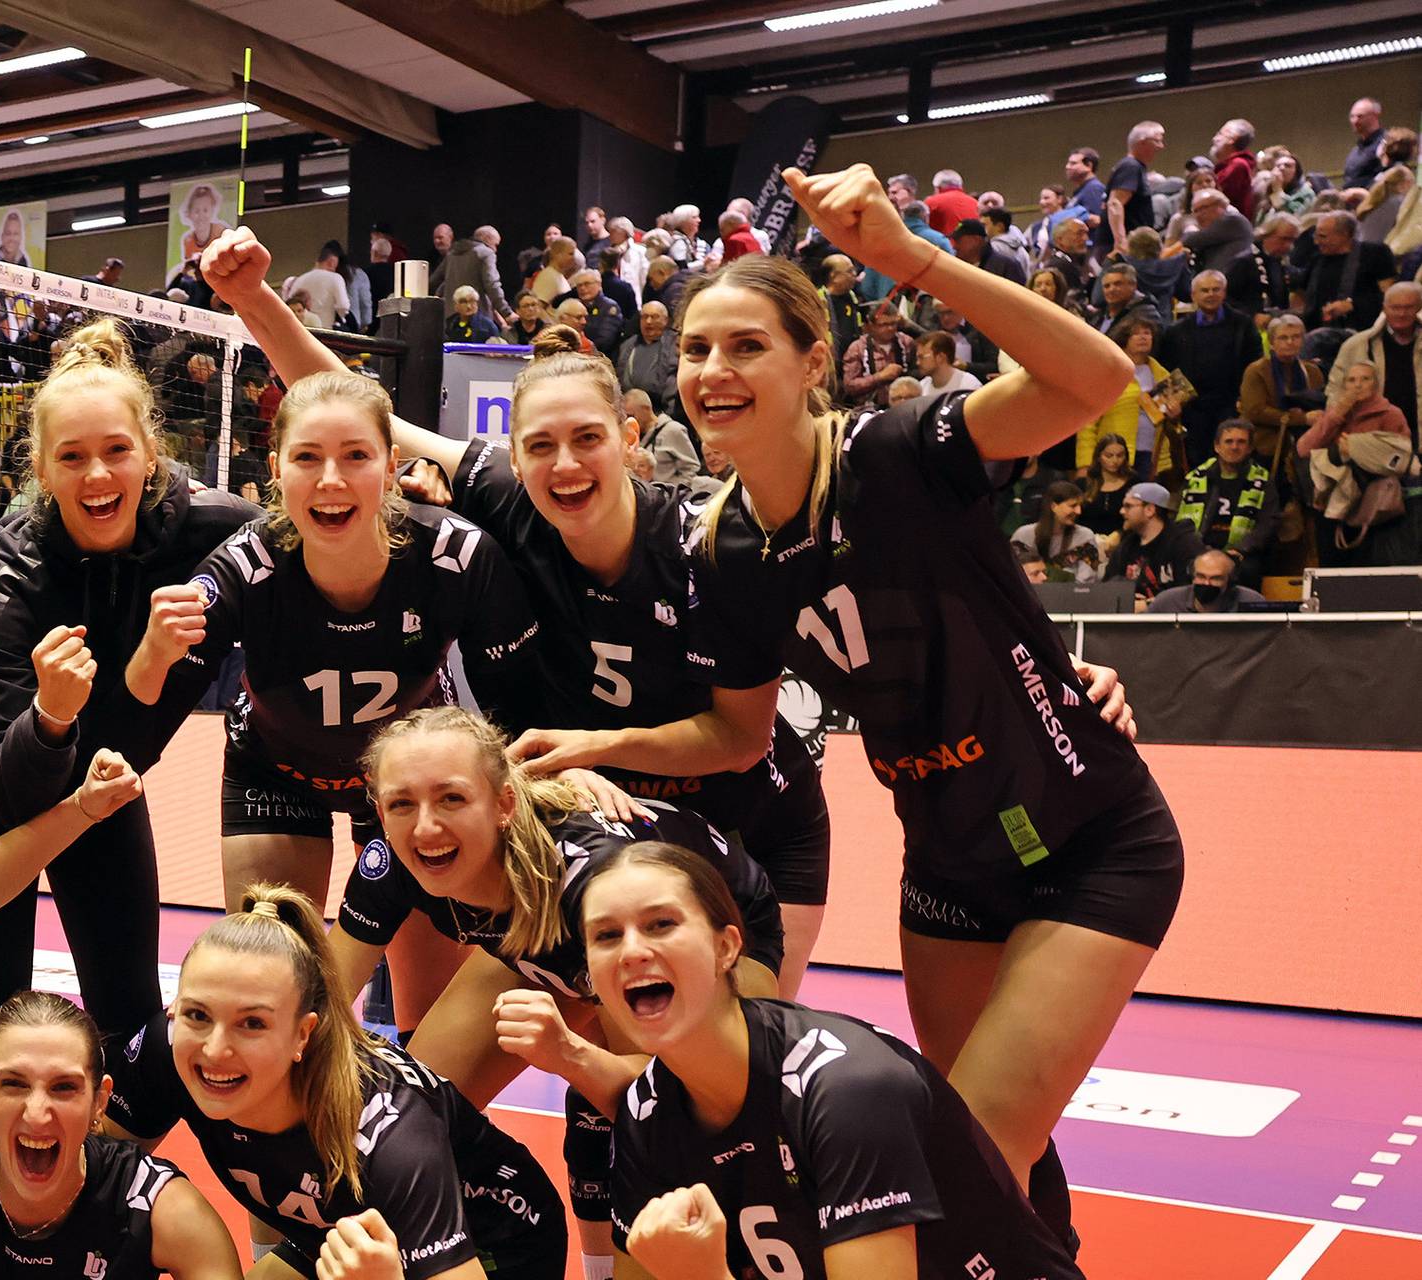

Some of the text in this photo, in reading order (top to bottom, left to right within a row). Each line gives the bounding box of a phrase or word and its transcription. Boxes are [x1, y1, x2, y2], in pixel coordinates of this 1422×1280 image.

[1218, 498, 1231, 516] 2
[302, 668, 399, 727] 12
[590, 640, 633, 708] 5
[1010, 642, 1087, 778] EMERSON
[228, 1168, 338, 1229] 14
[834, 1191, 912, 1221] NetAachen
[5, 1245, 54, 1265] STANNO
[739, 1204, 805, 1280] 6
